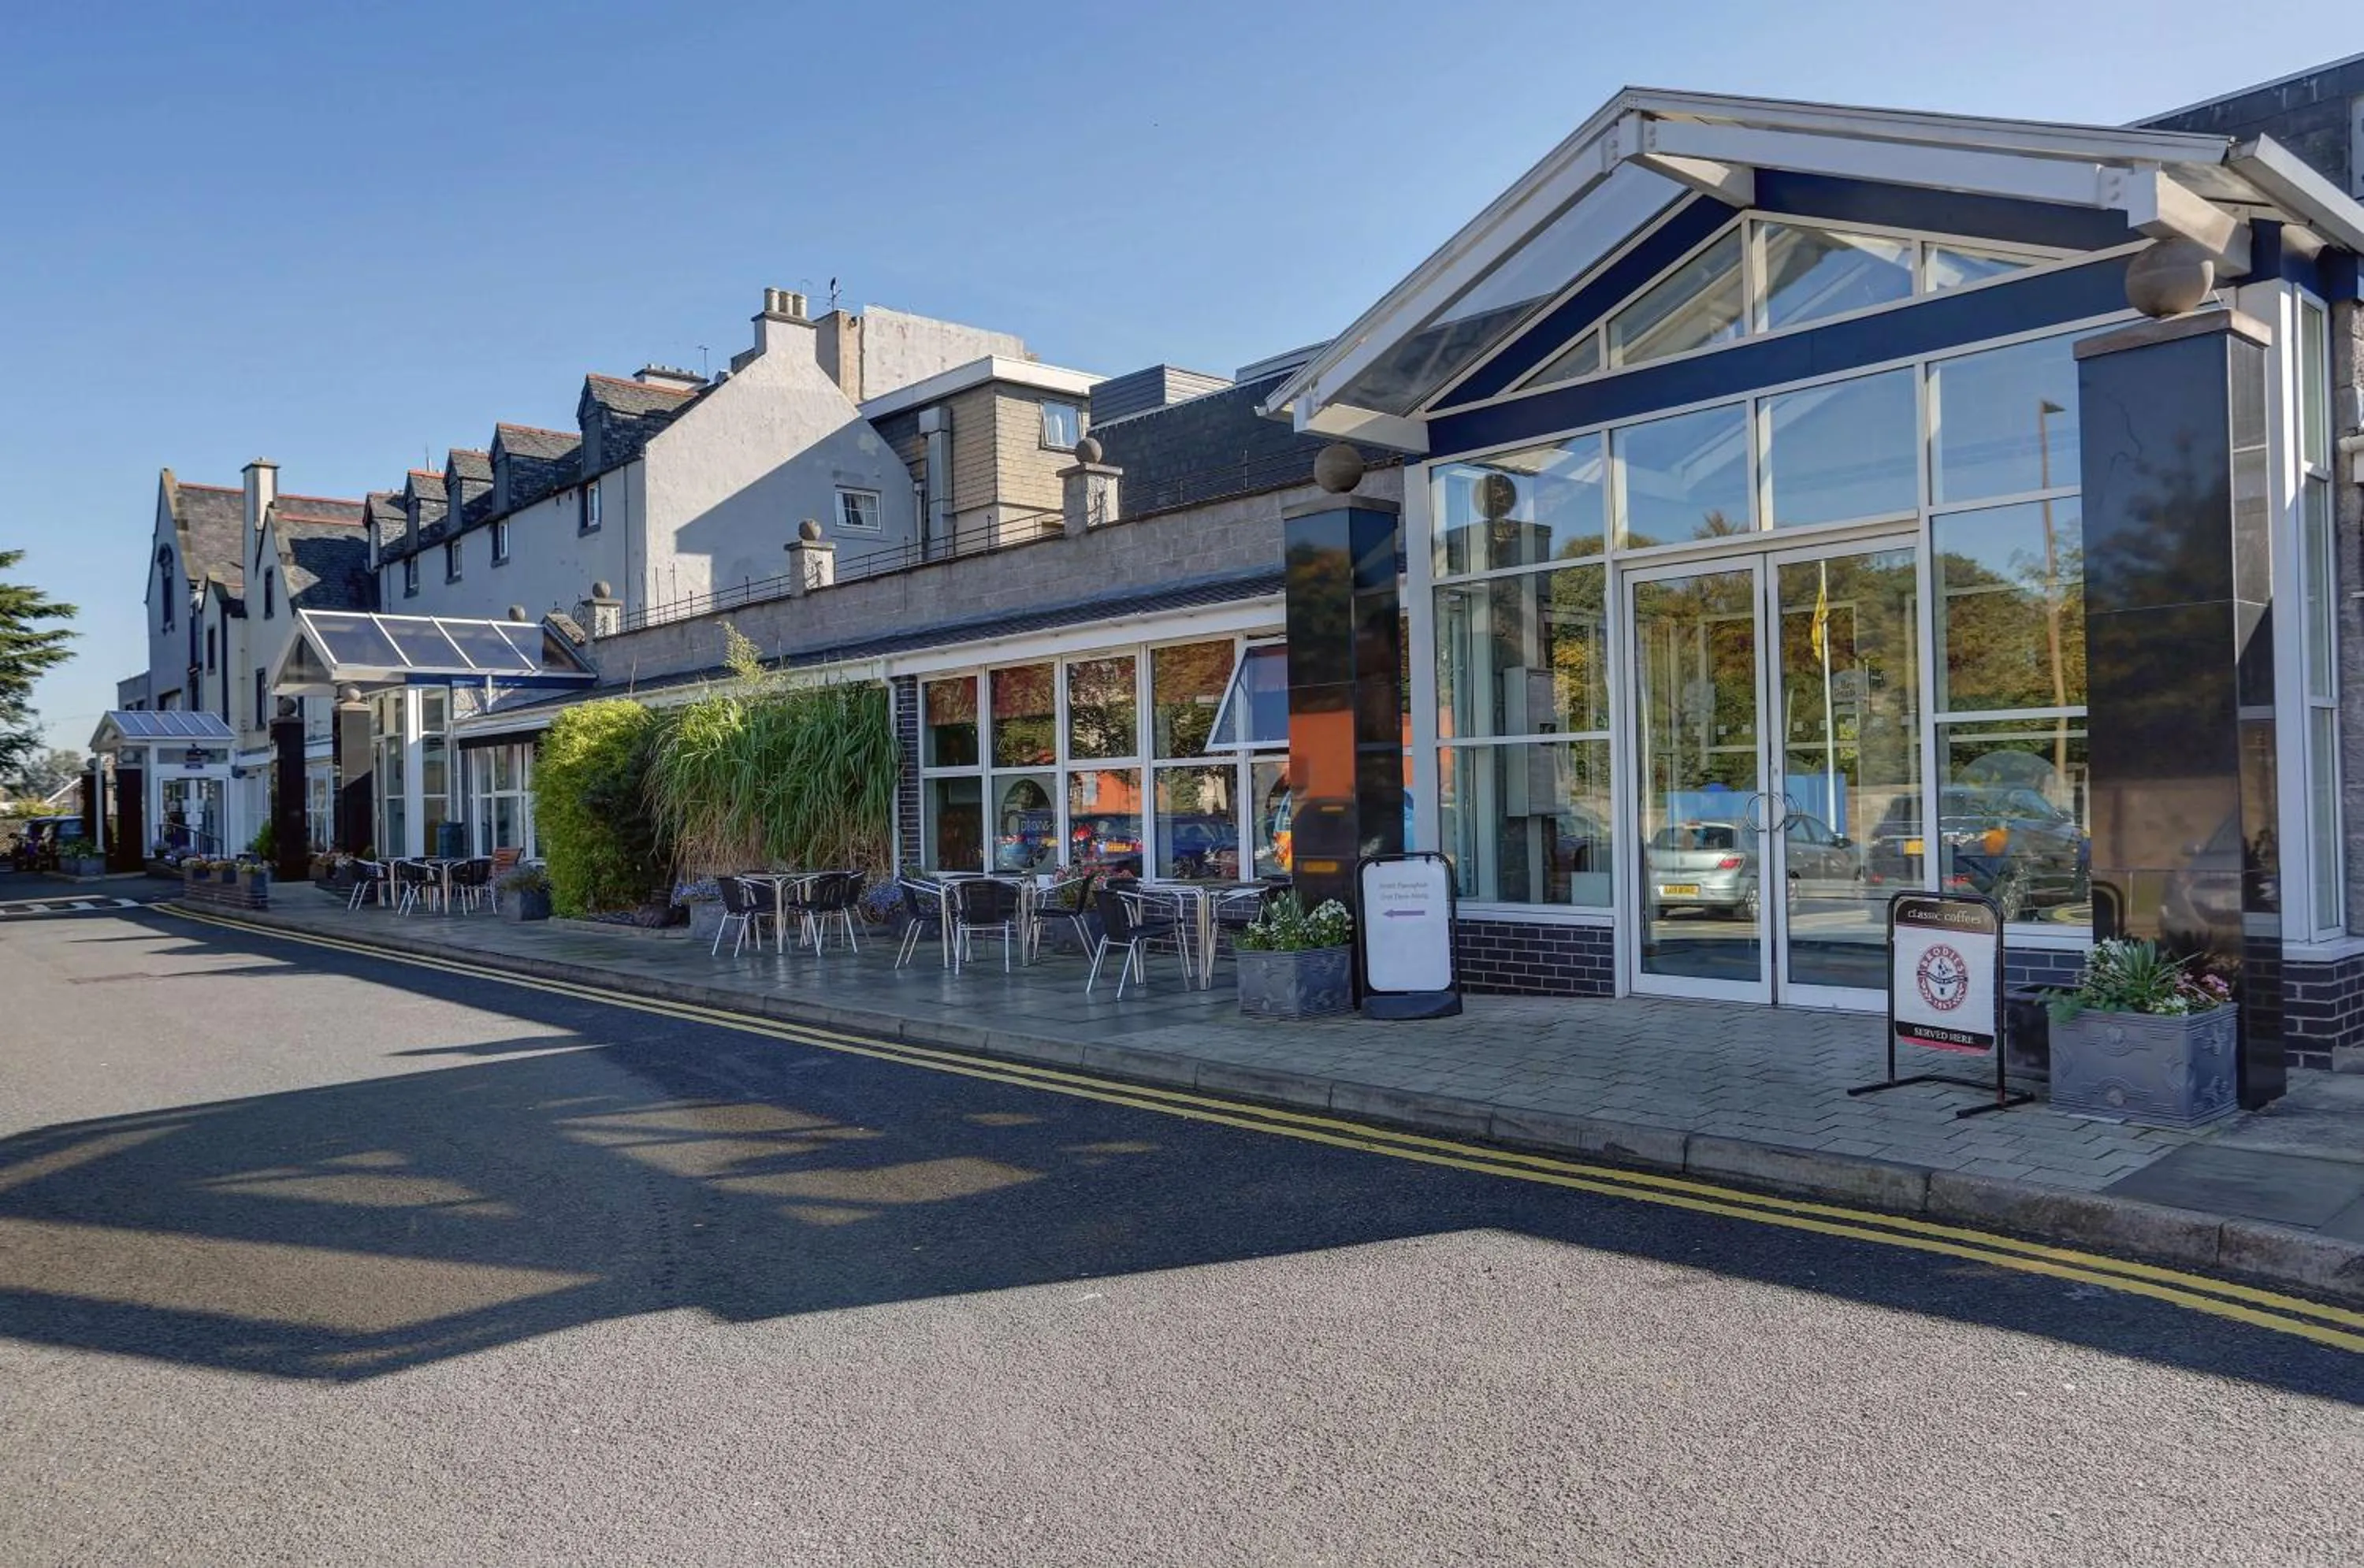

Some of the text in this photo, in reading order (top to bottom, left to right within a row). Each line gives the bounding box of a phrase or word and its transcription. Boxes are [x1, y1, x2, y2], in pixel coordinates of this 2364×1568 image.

[1908, 908, 1981, 924] classic coffees
[1913, 1027, 1974, 1044] SERVED HERE
